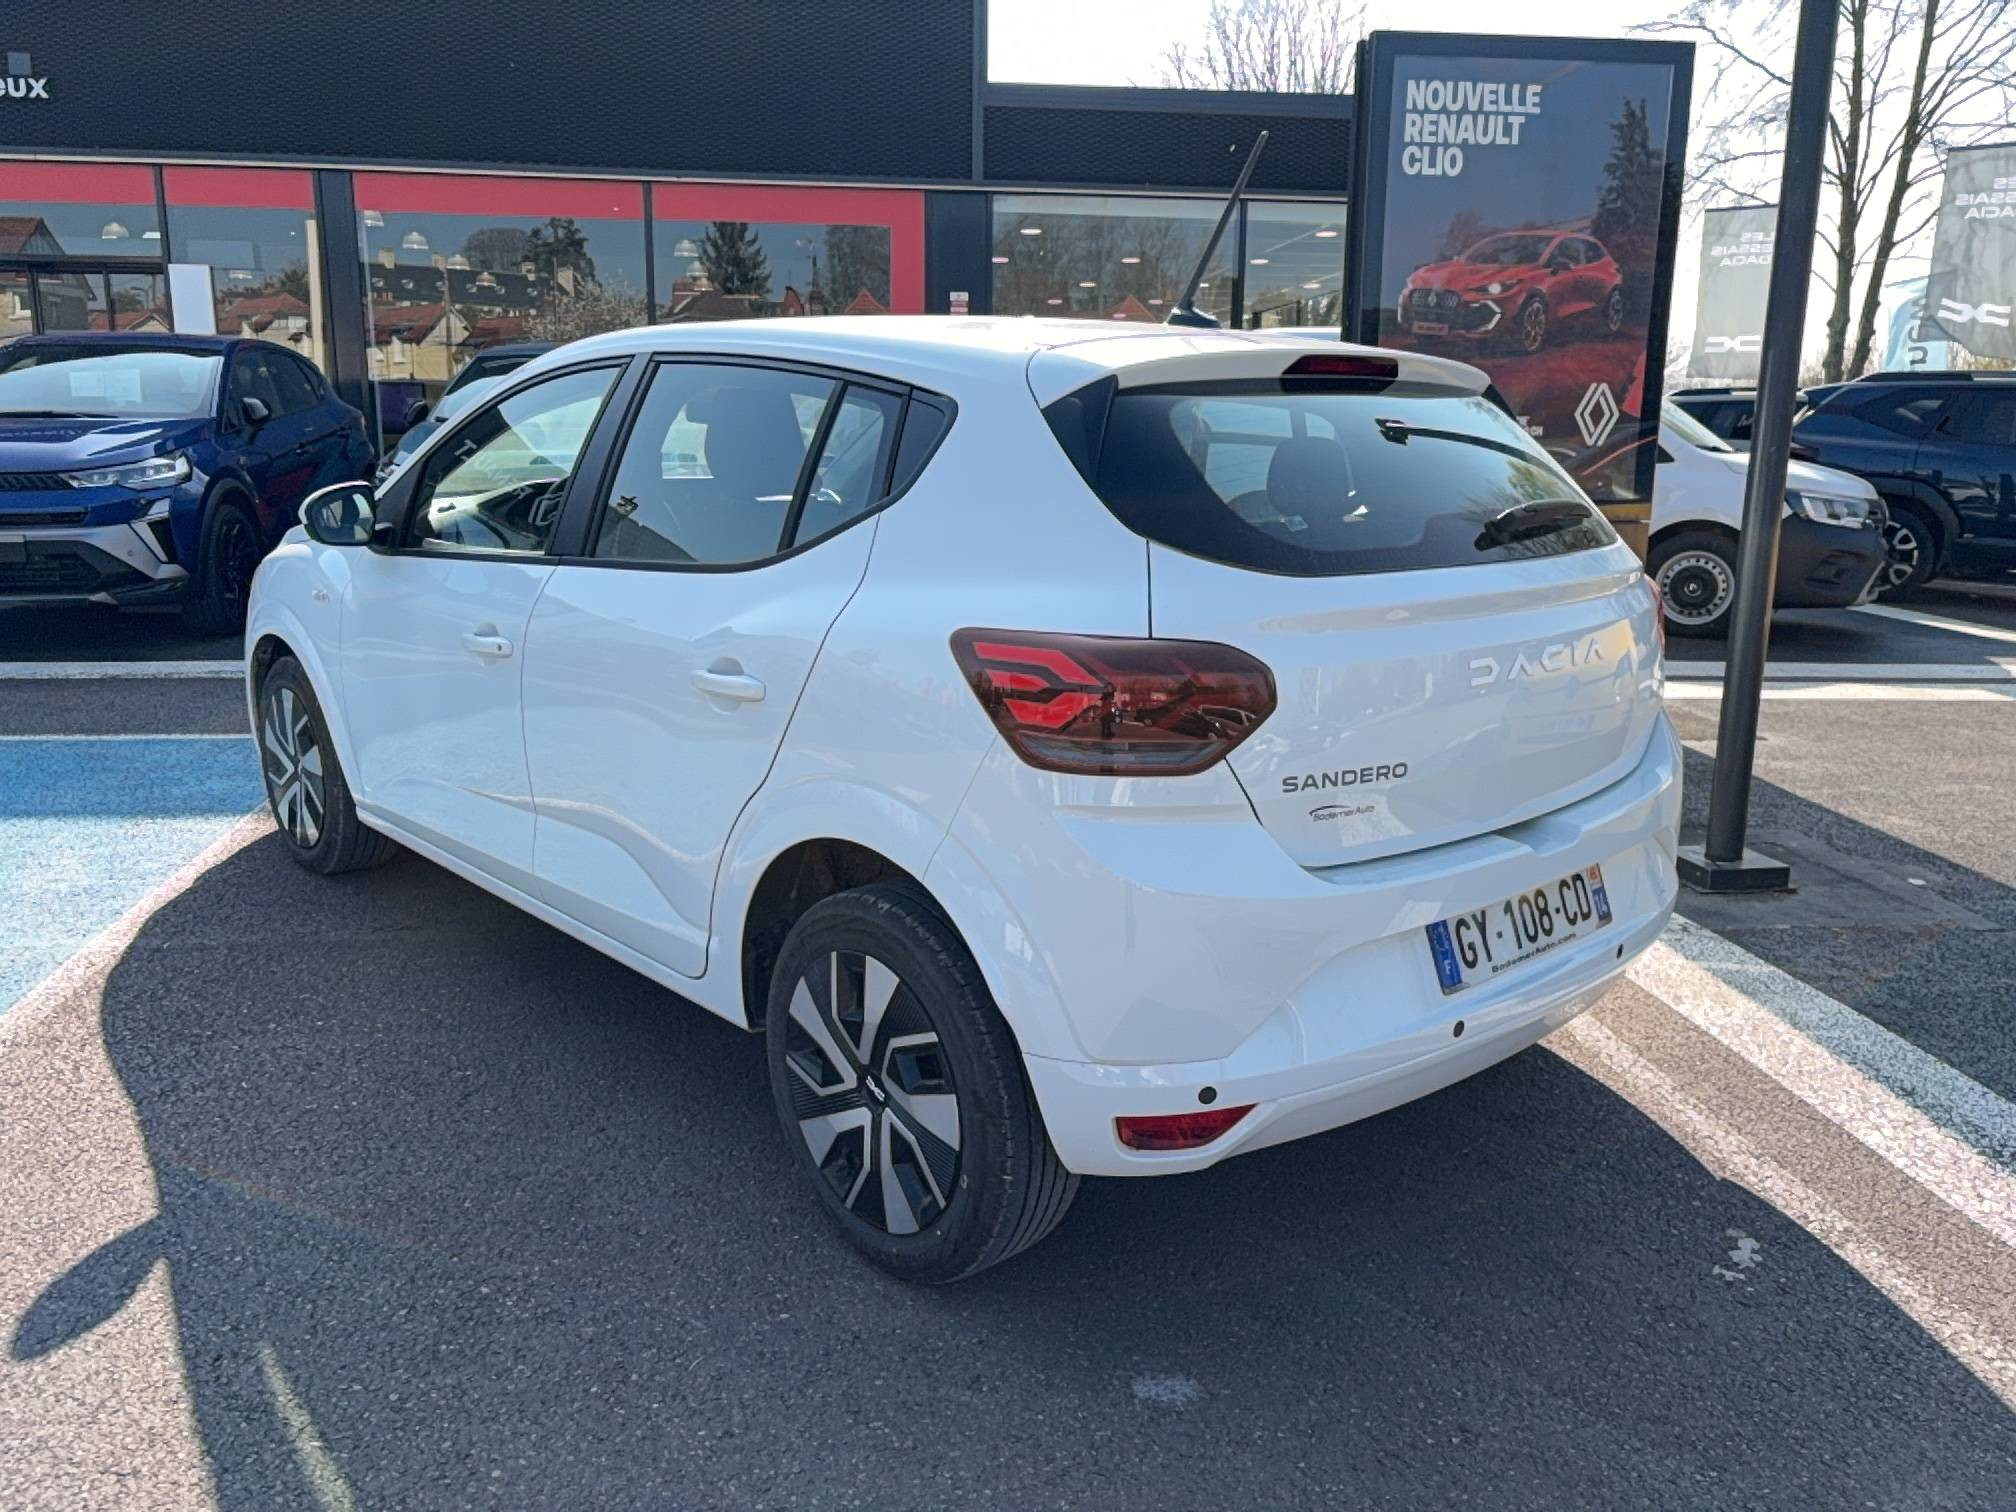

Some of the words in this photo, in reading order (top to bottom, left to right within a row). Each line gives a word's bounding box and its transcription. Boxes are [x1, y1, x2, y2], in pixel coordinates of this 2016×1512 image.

[1406, 79, 1543, 114] NOUVELLE
[1404, 112, 1526, 145] RENAULT
[1402, 145, 1463, 177] CLIO
[1469, 638, 1604, 687] DACIA
[1282, 762, 1408, 794] SANDERO
